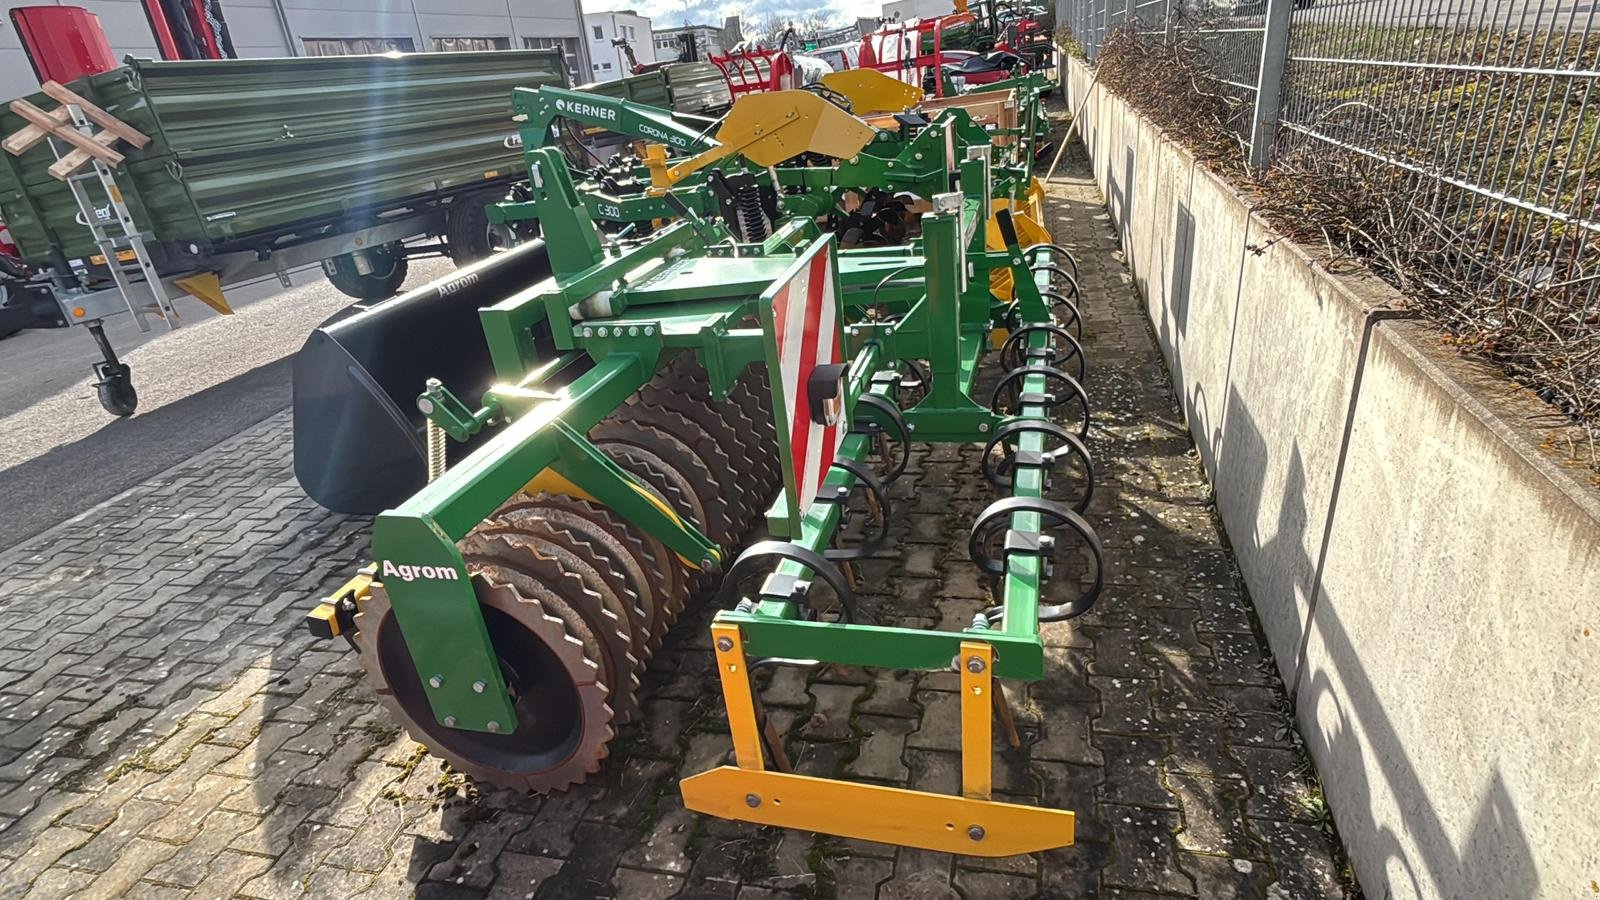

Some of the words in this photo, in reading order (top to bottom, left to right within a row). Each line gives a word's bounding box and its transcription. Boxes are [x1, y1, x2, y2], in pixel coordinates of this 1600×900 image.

[566, 100, 617, 121] KERNER
[638, 123, 669, 141] CORONA
[669, 136, 687, 147] 300
[597, 203, 605, 215] C
[604, 204, 620, 218] 300
[438, 273, 479, 298] Agrom
[383, 560, 458, 581] Agrom
